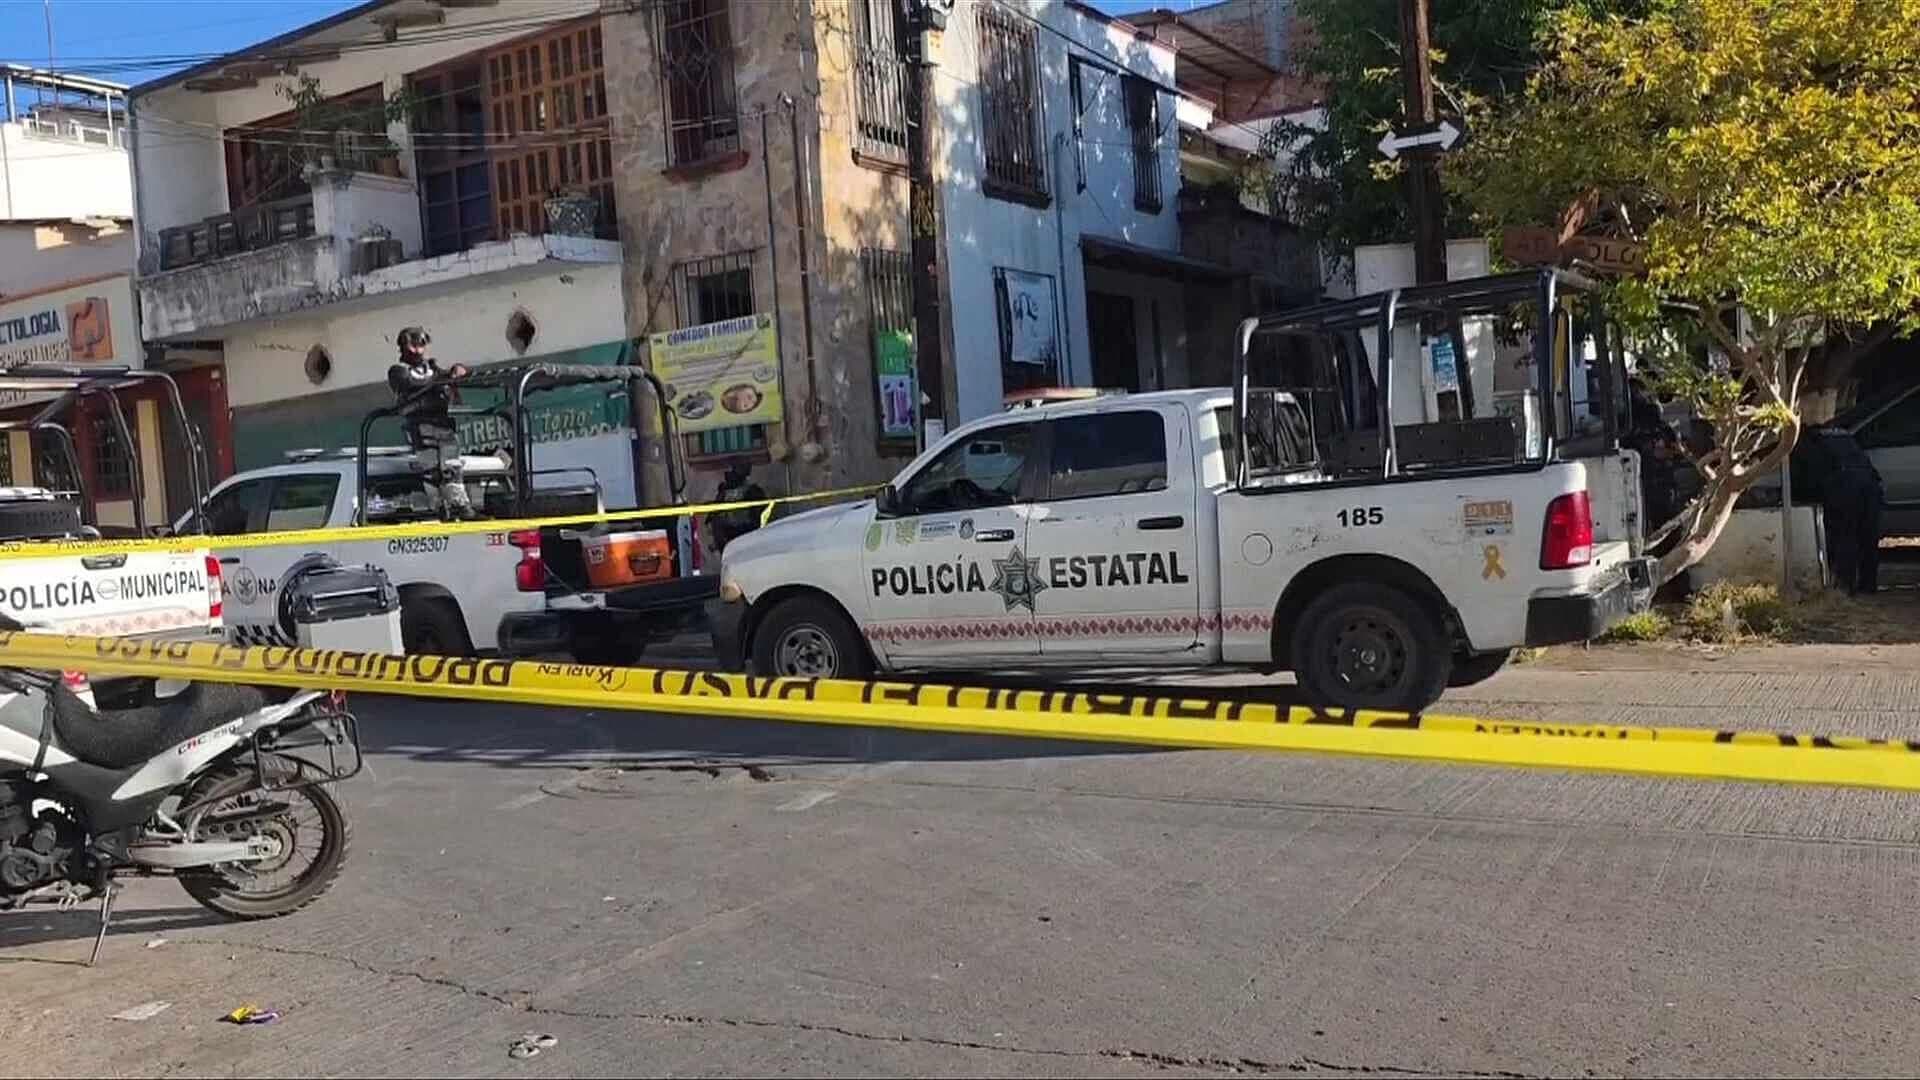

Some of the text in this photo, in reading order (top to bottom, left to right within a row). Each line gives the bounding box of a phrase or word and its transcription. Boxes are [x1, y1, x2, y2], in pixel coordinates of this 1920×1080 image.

[712, 318, 755, 336] FAMILIAR
[1336, 507, 1384, 527] 185
[388, 536, 449, 554] GN325307
[872, 552, 1189, 597] POLICÍA ESTATAL
[120, 570, 205, 600] MUNICIPAL
